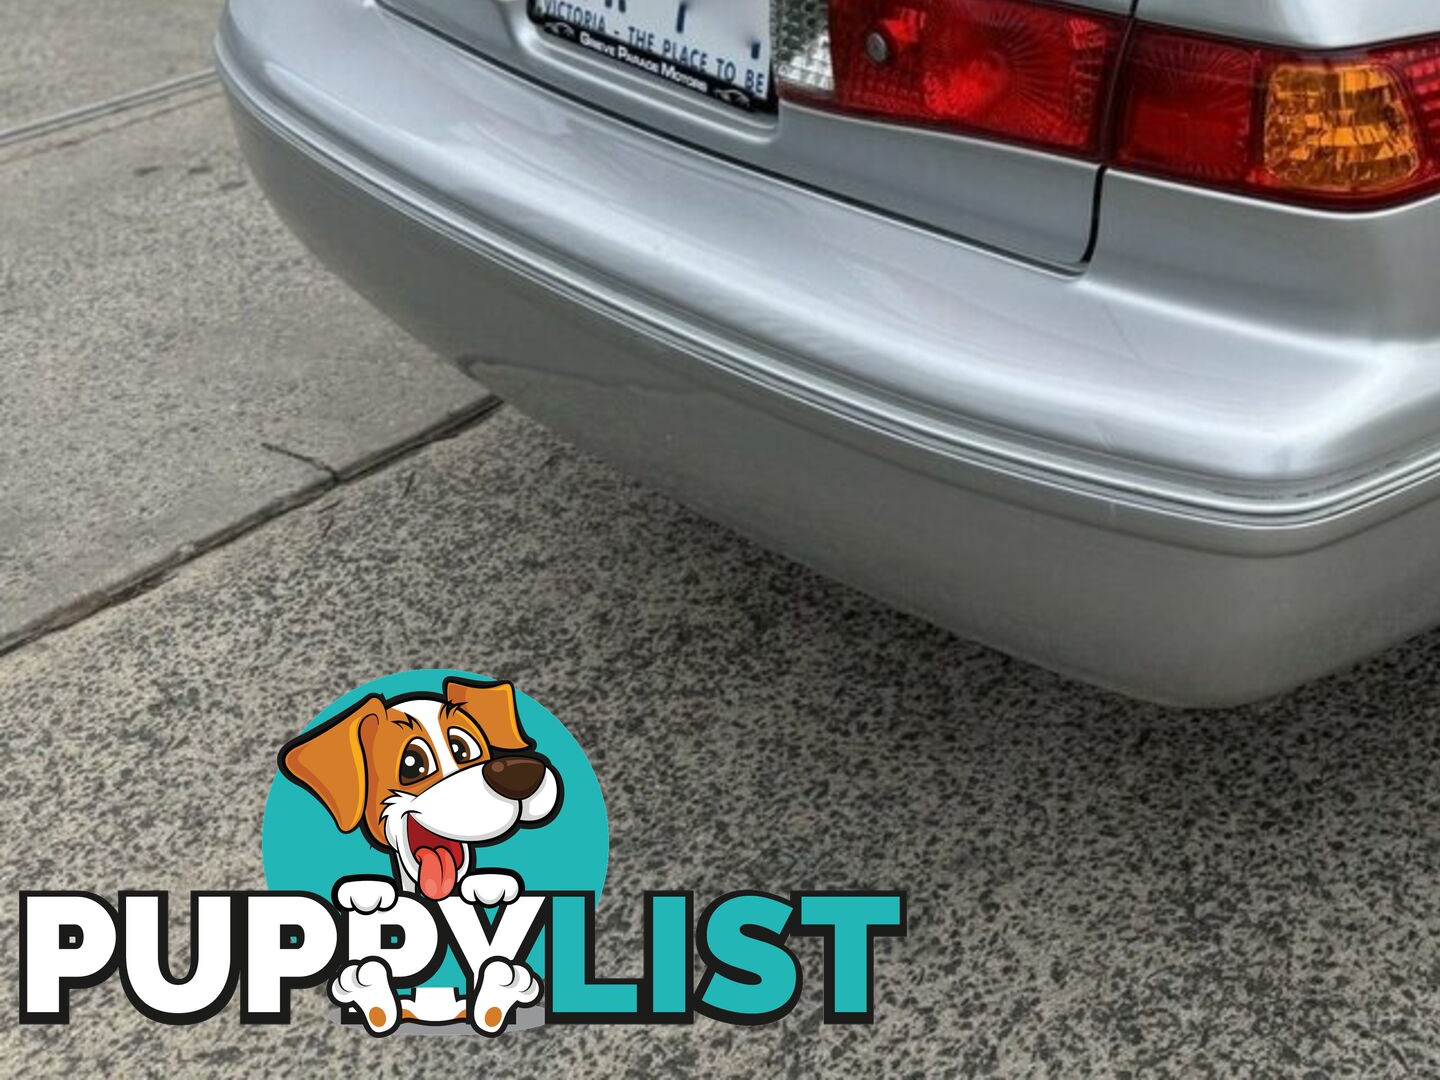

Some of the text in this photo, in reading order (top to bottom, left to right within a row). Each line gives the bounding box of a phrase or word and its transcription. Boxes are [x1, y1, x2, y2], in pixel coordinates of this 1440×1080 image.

[627, 25, 655, 51] THE
[662, 39, 708, 70] PLACE
[715, 57, 737, 84] TO
[745, 70, 765, 94] BE
